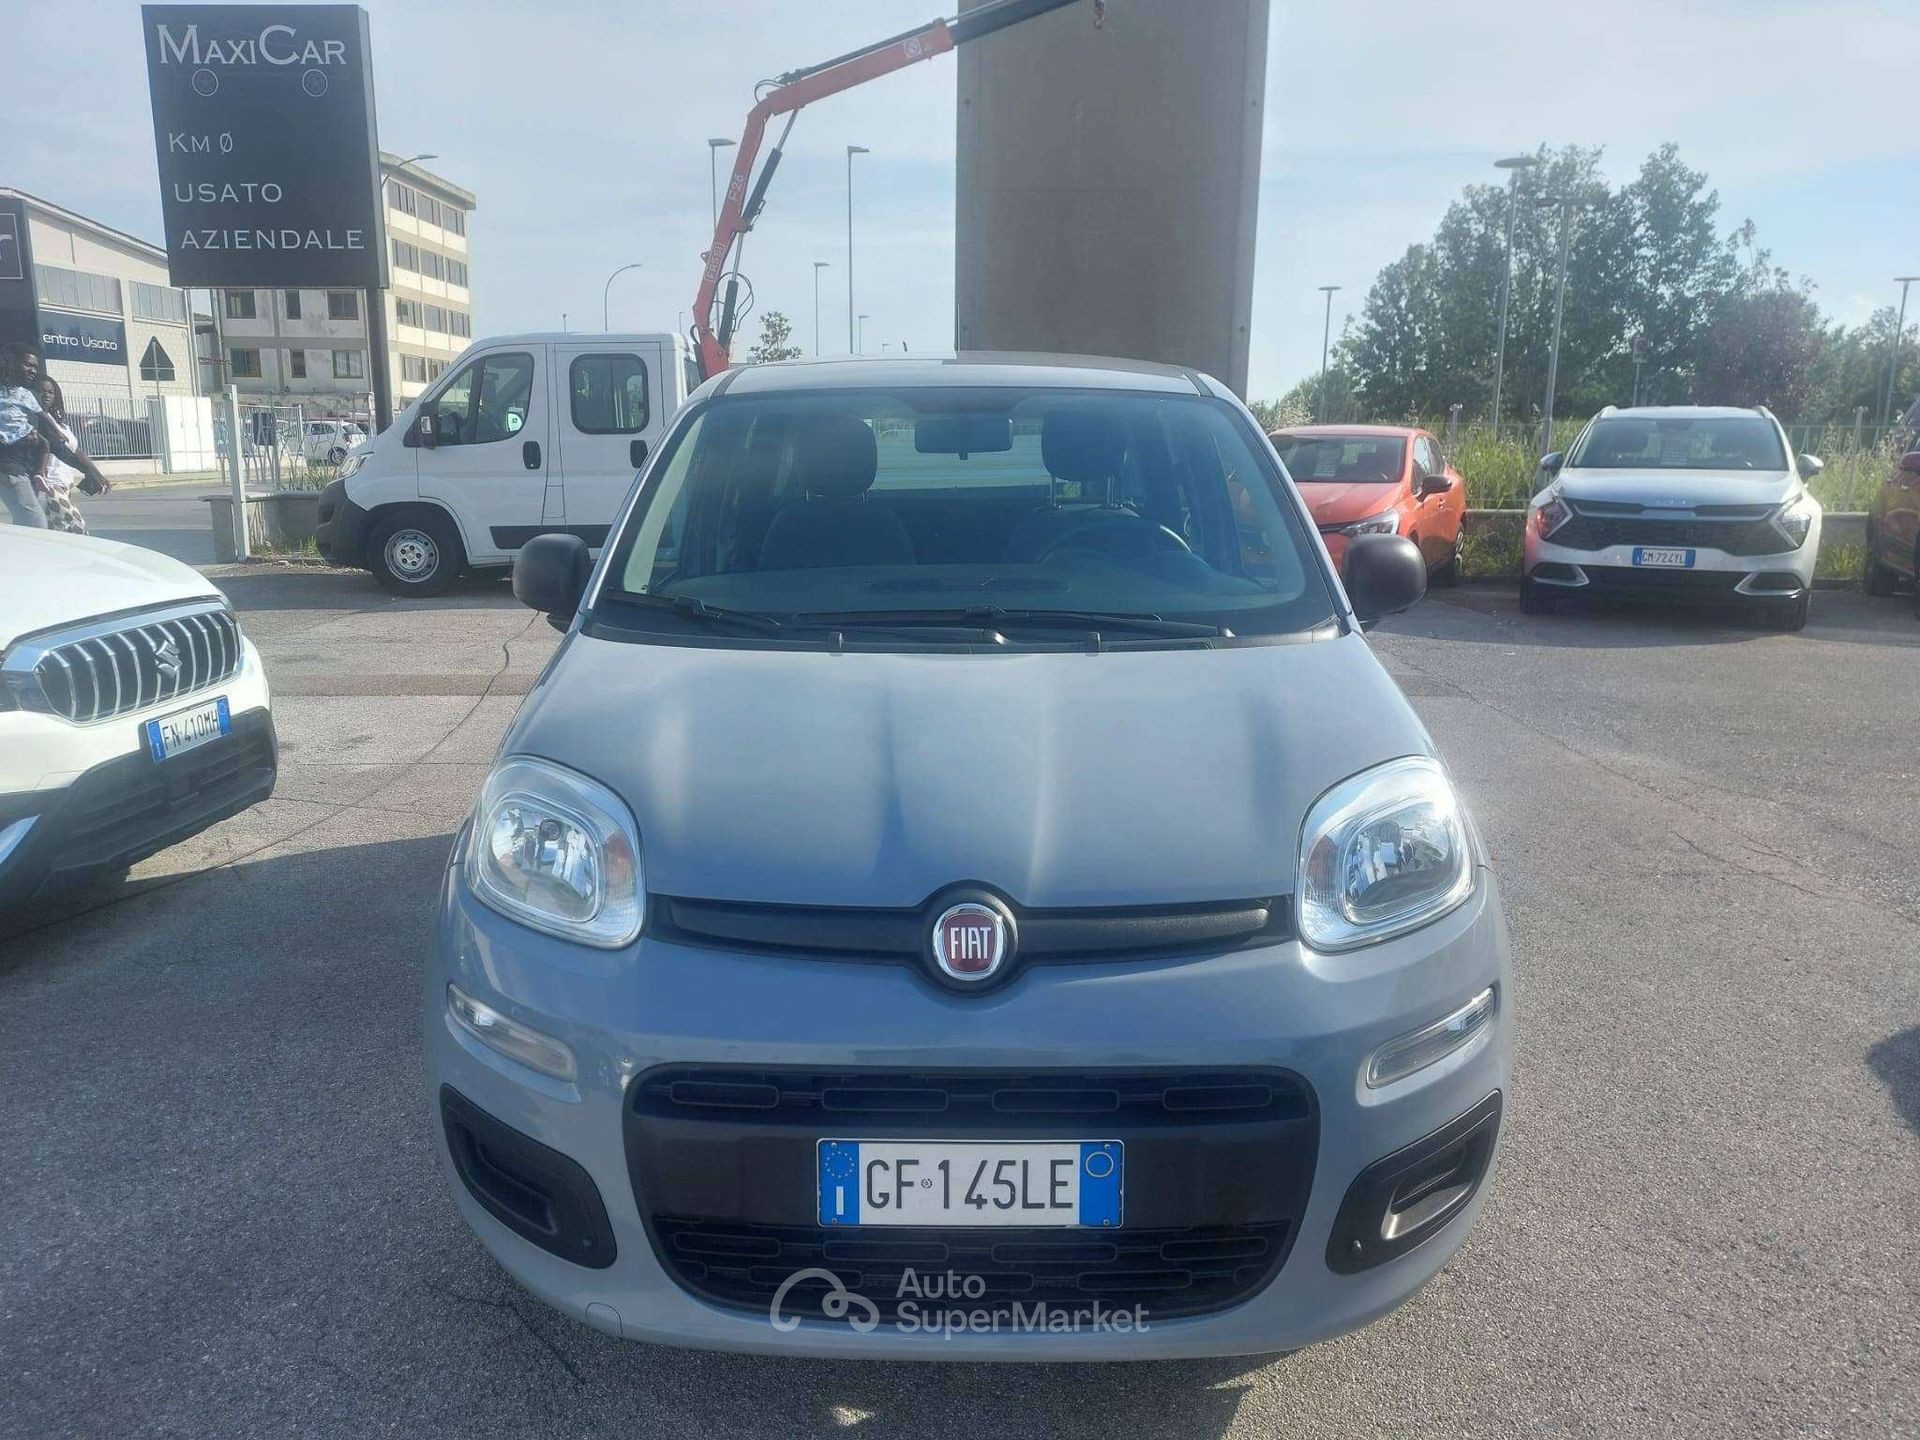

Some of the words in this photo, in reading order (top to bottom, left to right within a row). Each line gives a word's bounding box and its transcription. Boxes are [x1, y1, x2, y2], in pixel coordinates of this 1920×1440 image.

[174, 183, 282, 203] USATO
[181, 229, 365, 249] AZIENDALE
[42, 334, 79, 346] entro
[81, 335, 118, 351] Usato
[950, 927, 991, 960] FIAT
